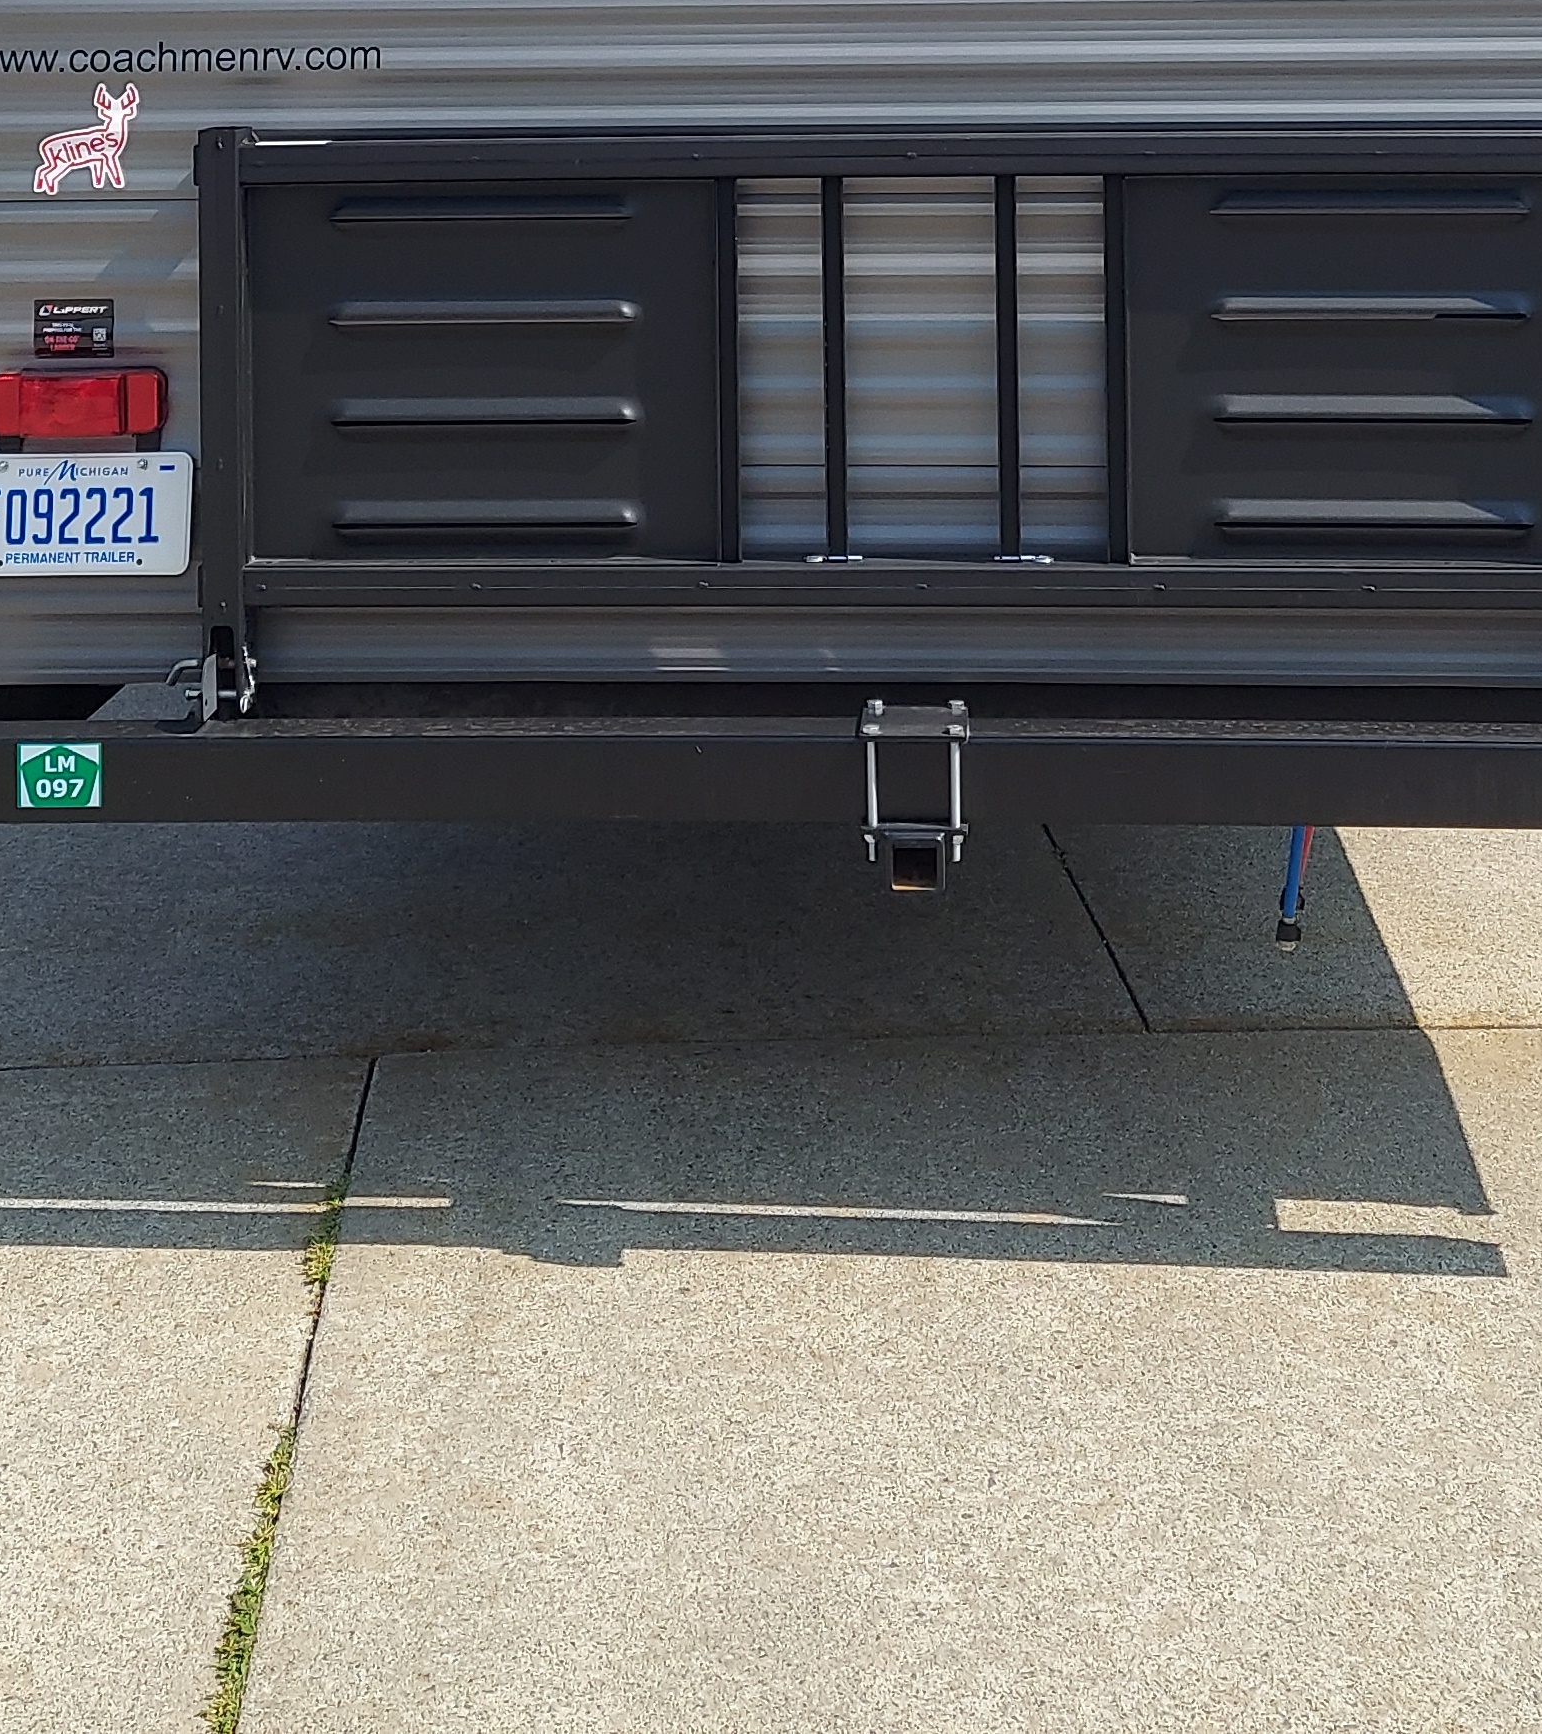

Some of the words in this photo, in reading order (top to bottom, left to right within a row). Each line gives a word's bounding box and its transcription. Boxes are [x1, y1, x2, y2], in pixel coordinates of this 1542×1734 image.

[49, 131, 118, 165] kline's
[18, 466, 50, 477] PURE
[44, 459, 129, 485] MICHIGAN
[5, 552, 81, 565] PERMANENT
[83, 551, 135, 563] TRAILER
[44, 755, 75, 773] LM
[35, 778, 85, 799] 097
